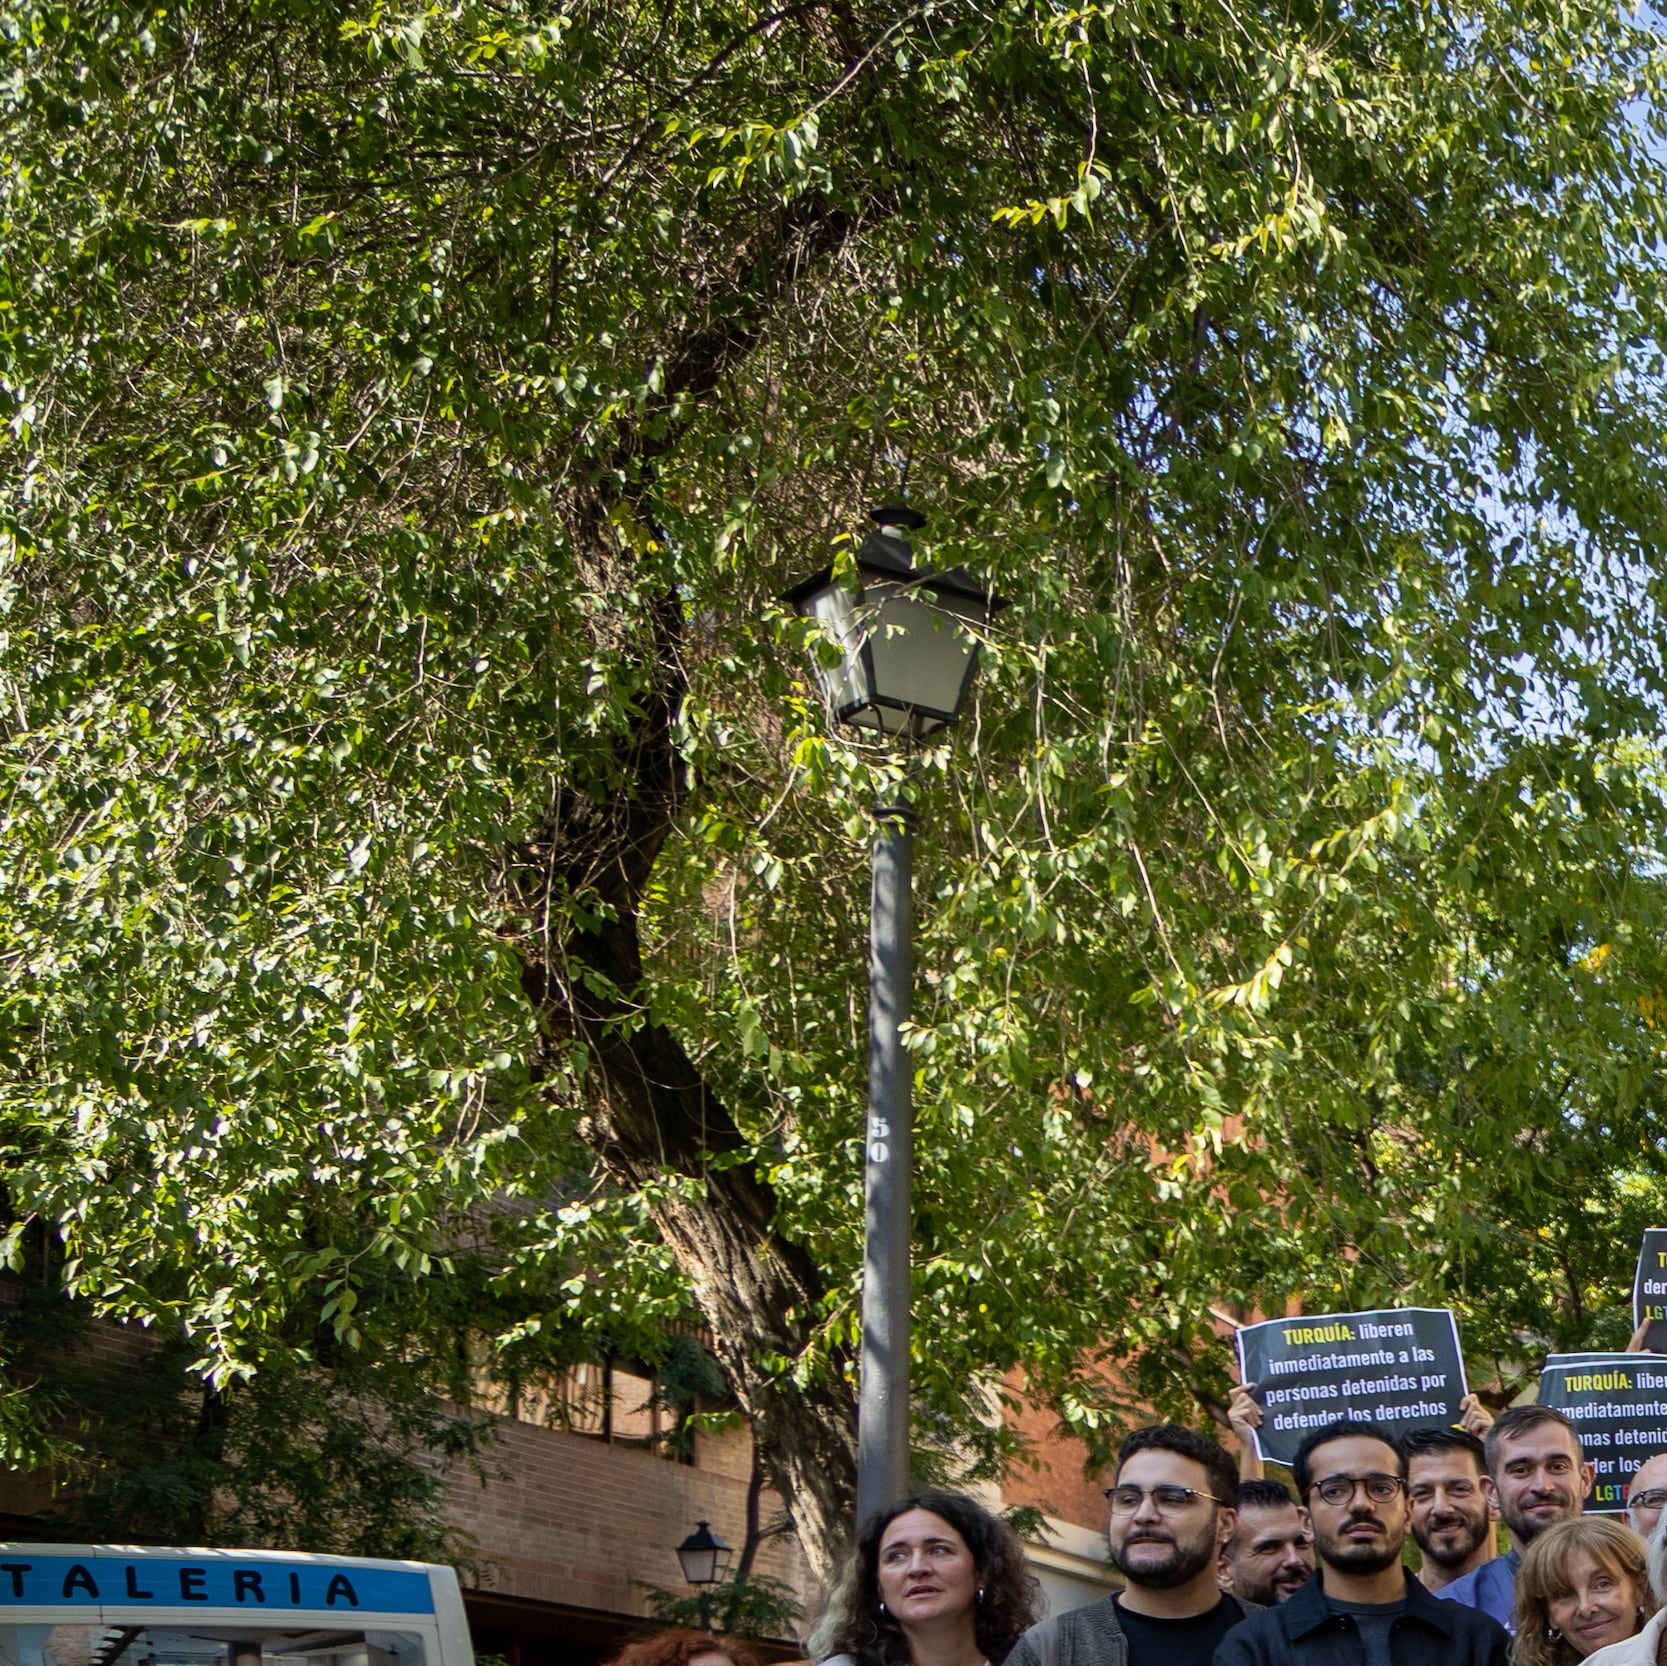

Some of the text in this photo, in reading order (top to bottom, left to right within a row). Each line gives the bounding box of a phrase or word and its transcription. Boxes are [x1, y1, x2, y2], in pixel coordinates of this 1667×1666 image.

[1283, 1322, 1413, 1346] TURQUÍA: liberen
[1269, 1346, 1435, 1376] inmediatamente a las
[1266, 1374, 1447, 1407] personas detenidas por
[1565, 1370, 1632, 1392] TURQUÍA:
[1274, 1400, 1448, 1431] defender los derechos
[1619, 1456, 1641, 1473] los
